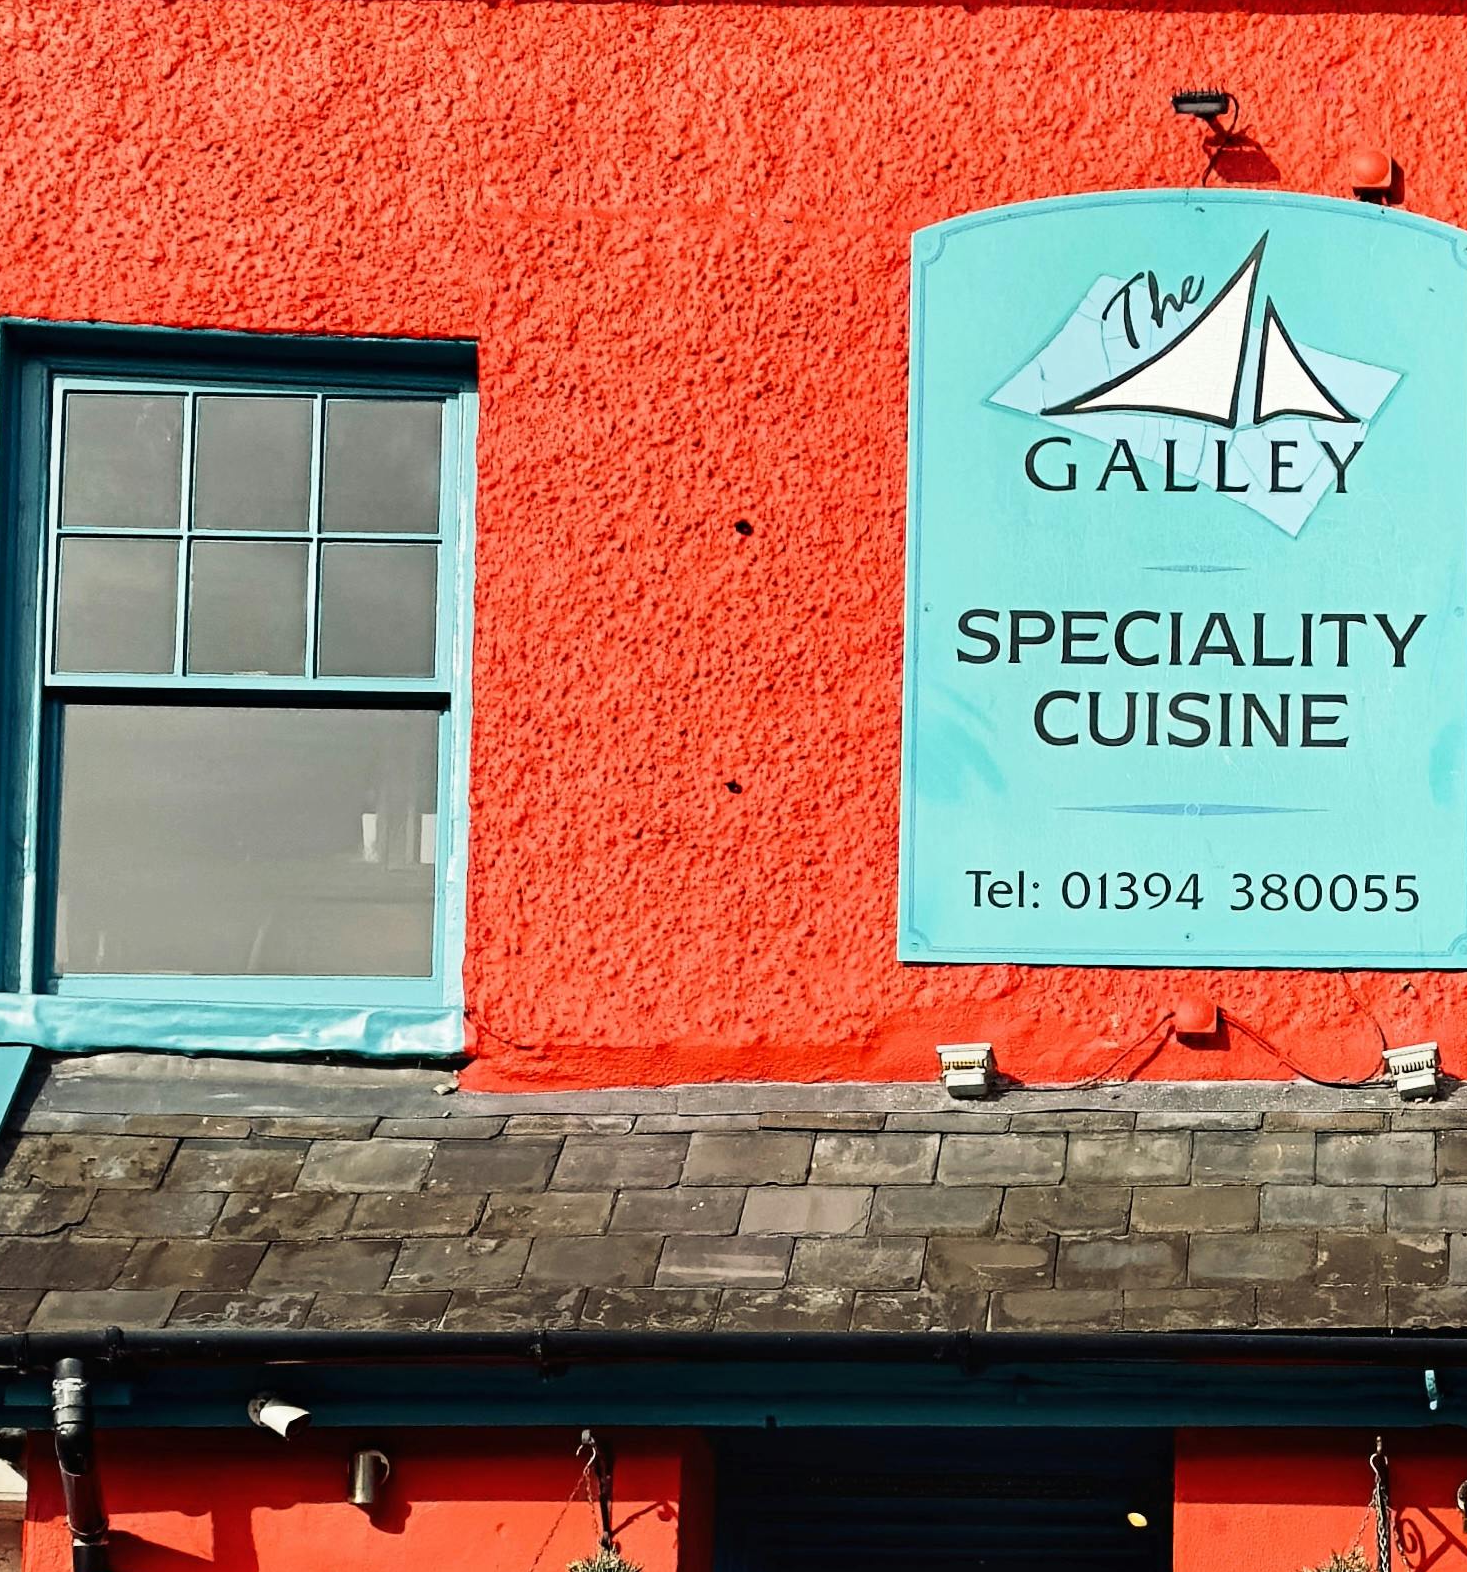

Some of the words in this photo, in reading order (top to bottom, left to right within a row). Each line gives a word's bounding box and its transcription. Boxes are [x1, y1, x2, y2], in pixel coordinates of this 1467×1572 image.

[1102, 270, 1205, 349] The
[1024, 436, 1364, 494] GALLEY
[956, 608, 1428, 668] SPECIALITY
[1033, 690, 1350, 748] CUISINE
[965, 870, 1041, 909] Tel:
[1061, 871, 1204, 911] 01394
[1230, 872, 1421, 913] 380055
